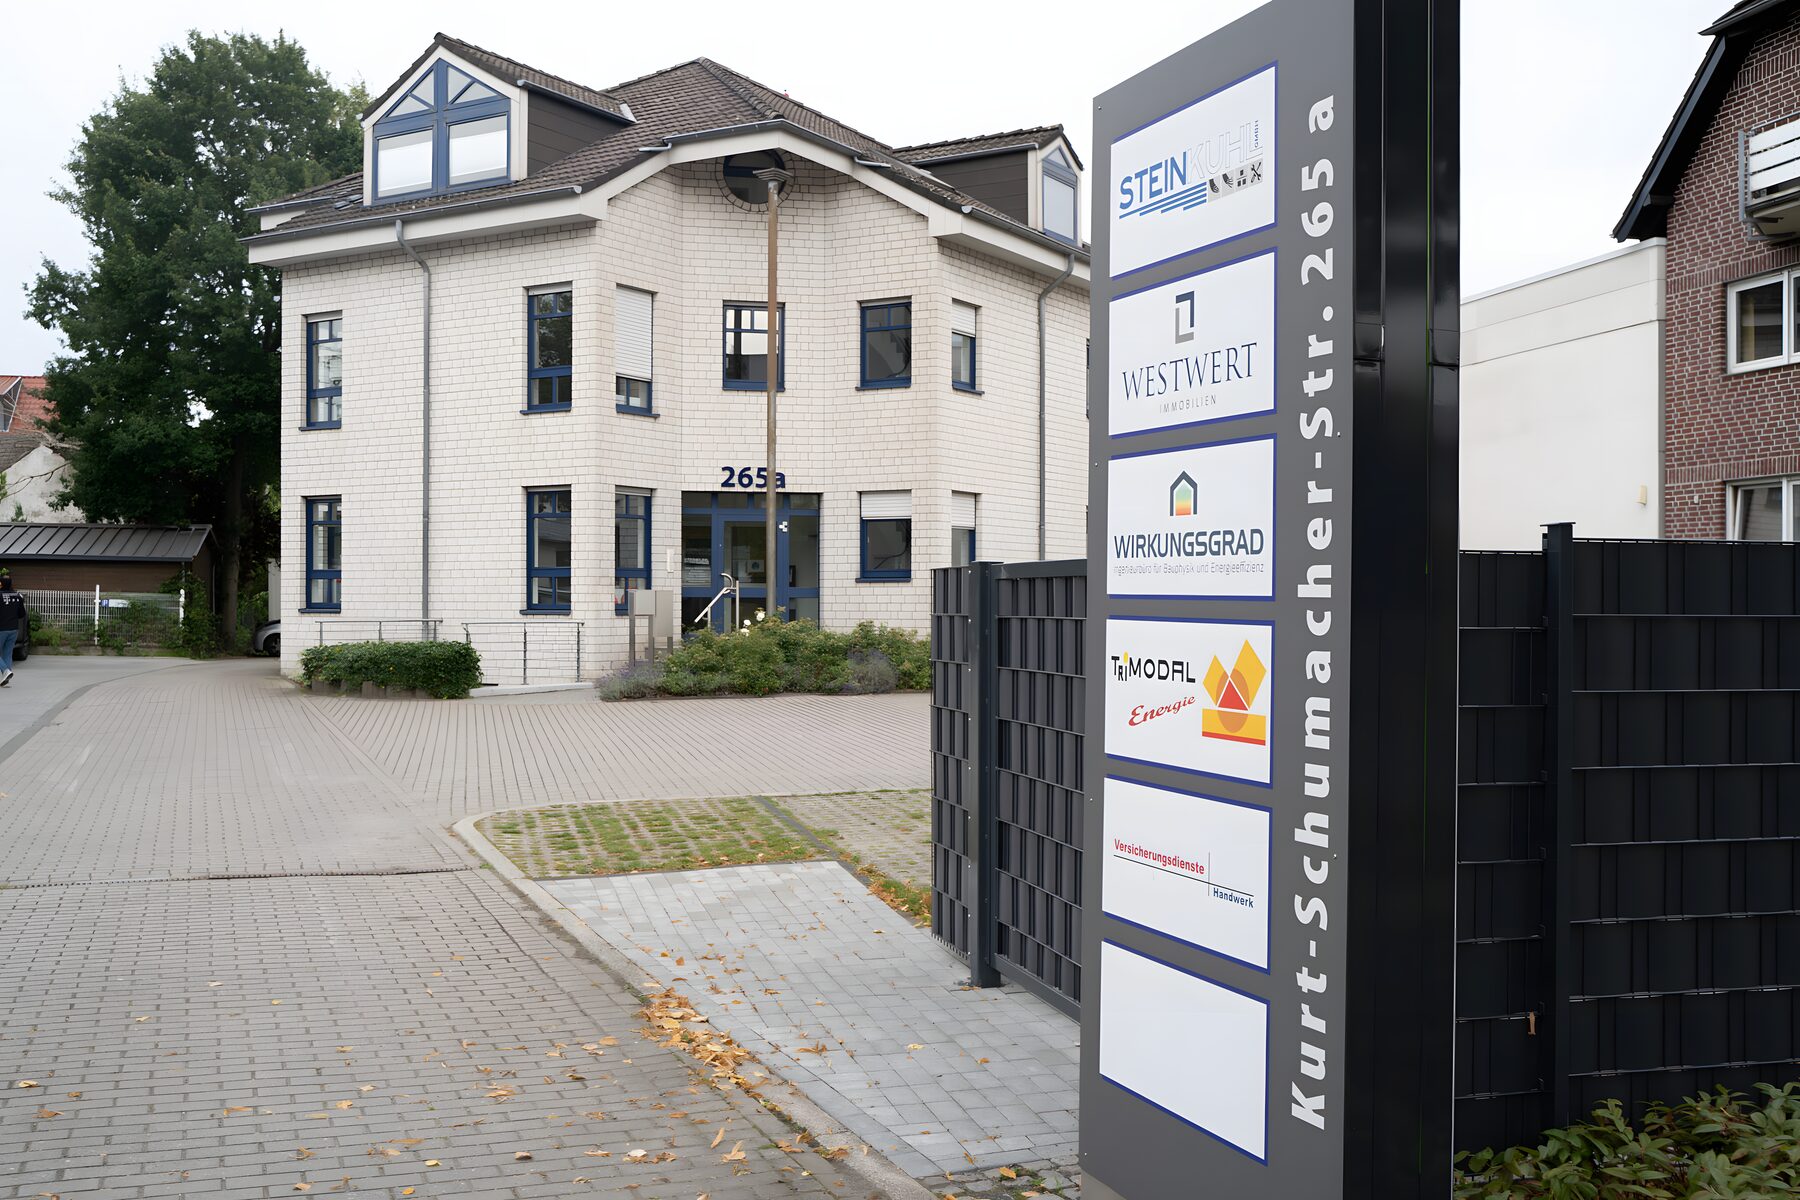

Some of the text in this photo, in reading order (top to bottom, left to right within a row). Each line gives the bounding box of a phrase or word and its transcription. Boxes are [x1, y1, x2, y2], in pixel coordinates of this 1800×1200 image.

[1121, 341, 1258, 401] WESTWERT
[1159, 393, 1217, 414] IMMOBILIEN
[720, 465, 786, 489] 265a
[1113, 527, 1265, 559] WIRKUNGSGRAD
[1163, 561, 1194, 575] Bauphysik
[1196, 561, 1209, 573] und
[1210, 560, 1265, 576] Energieeffizienz
[1128, 696, 1196, 727] Energie
[1291, 305, 1334, 1131] Kurt-Schumacher-Str.
[1113, 838, 1205, 875] Versicherungsdienste
[1213, 886, 1254, 909] Handwerk
